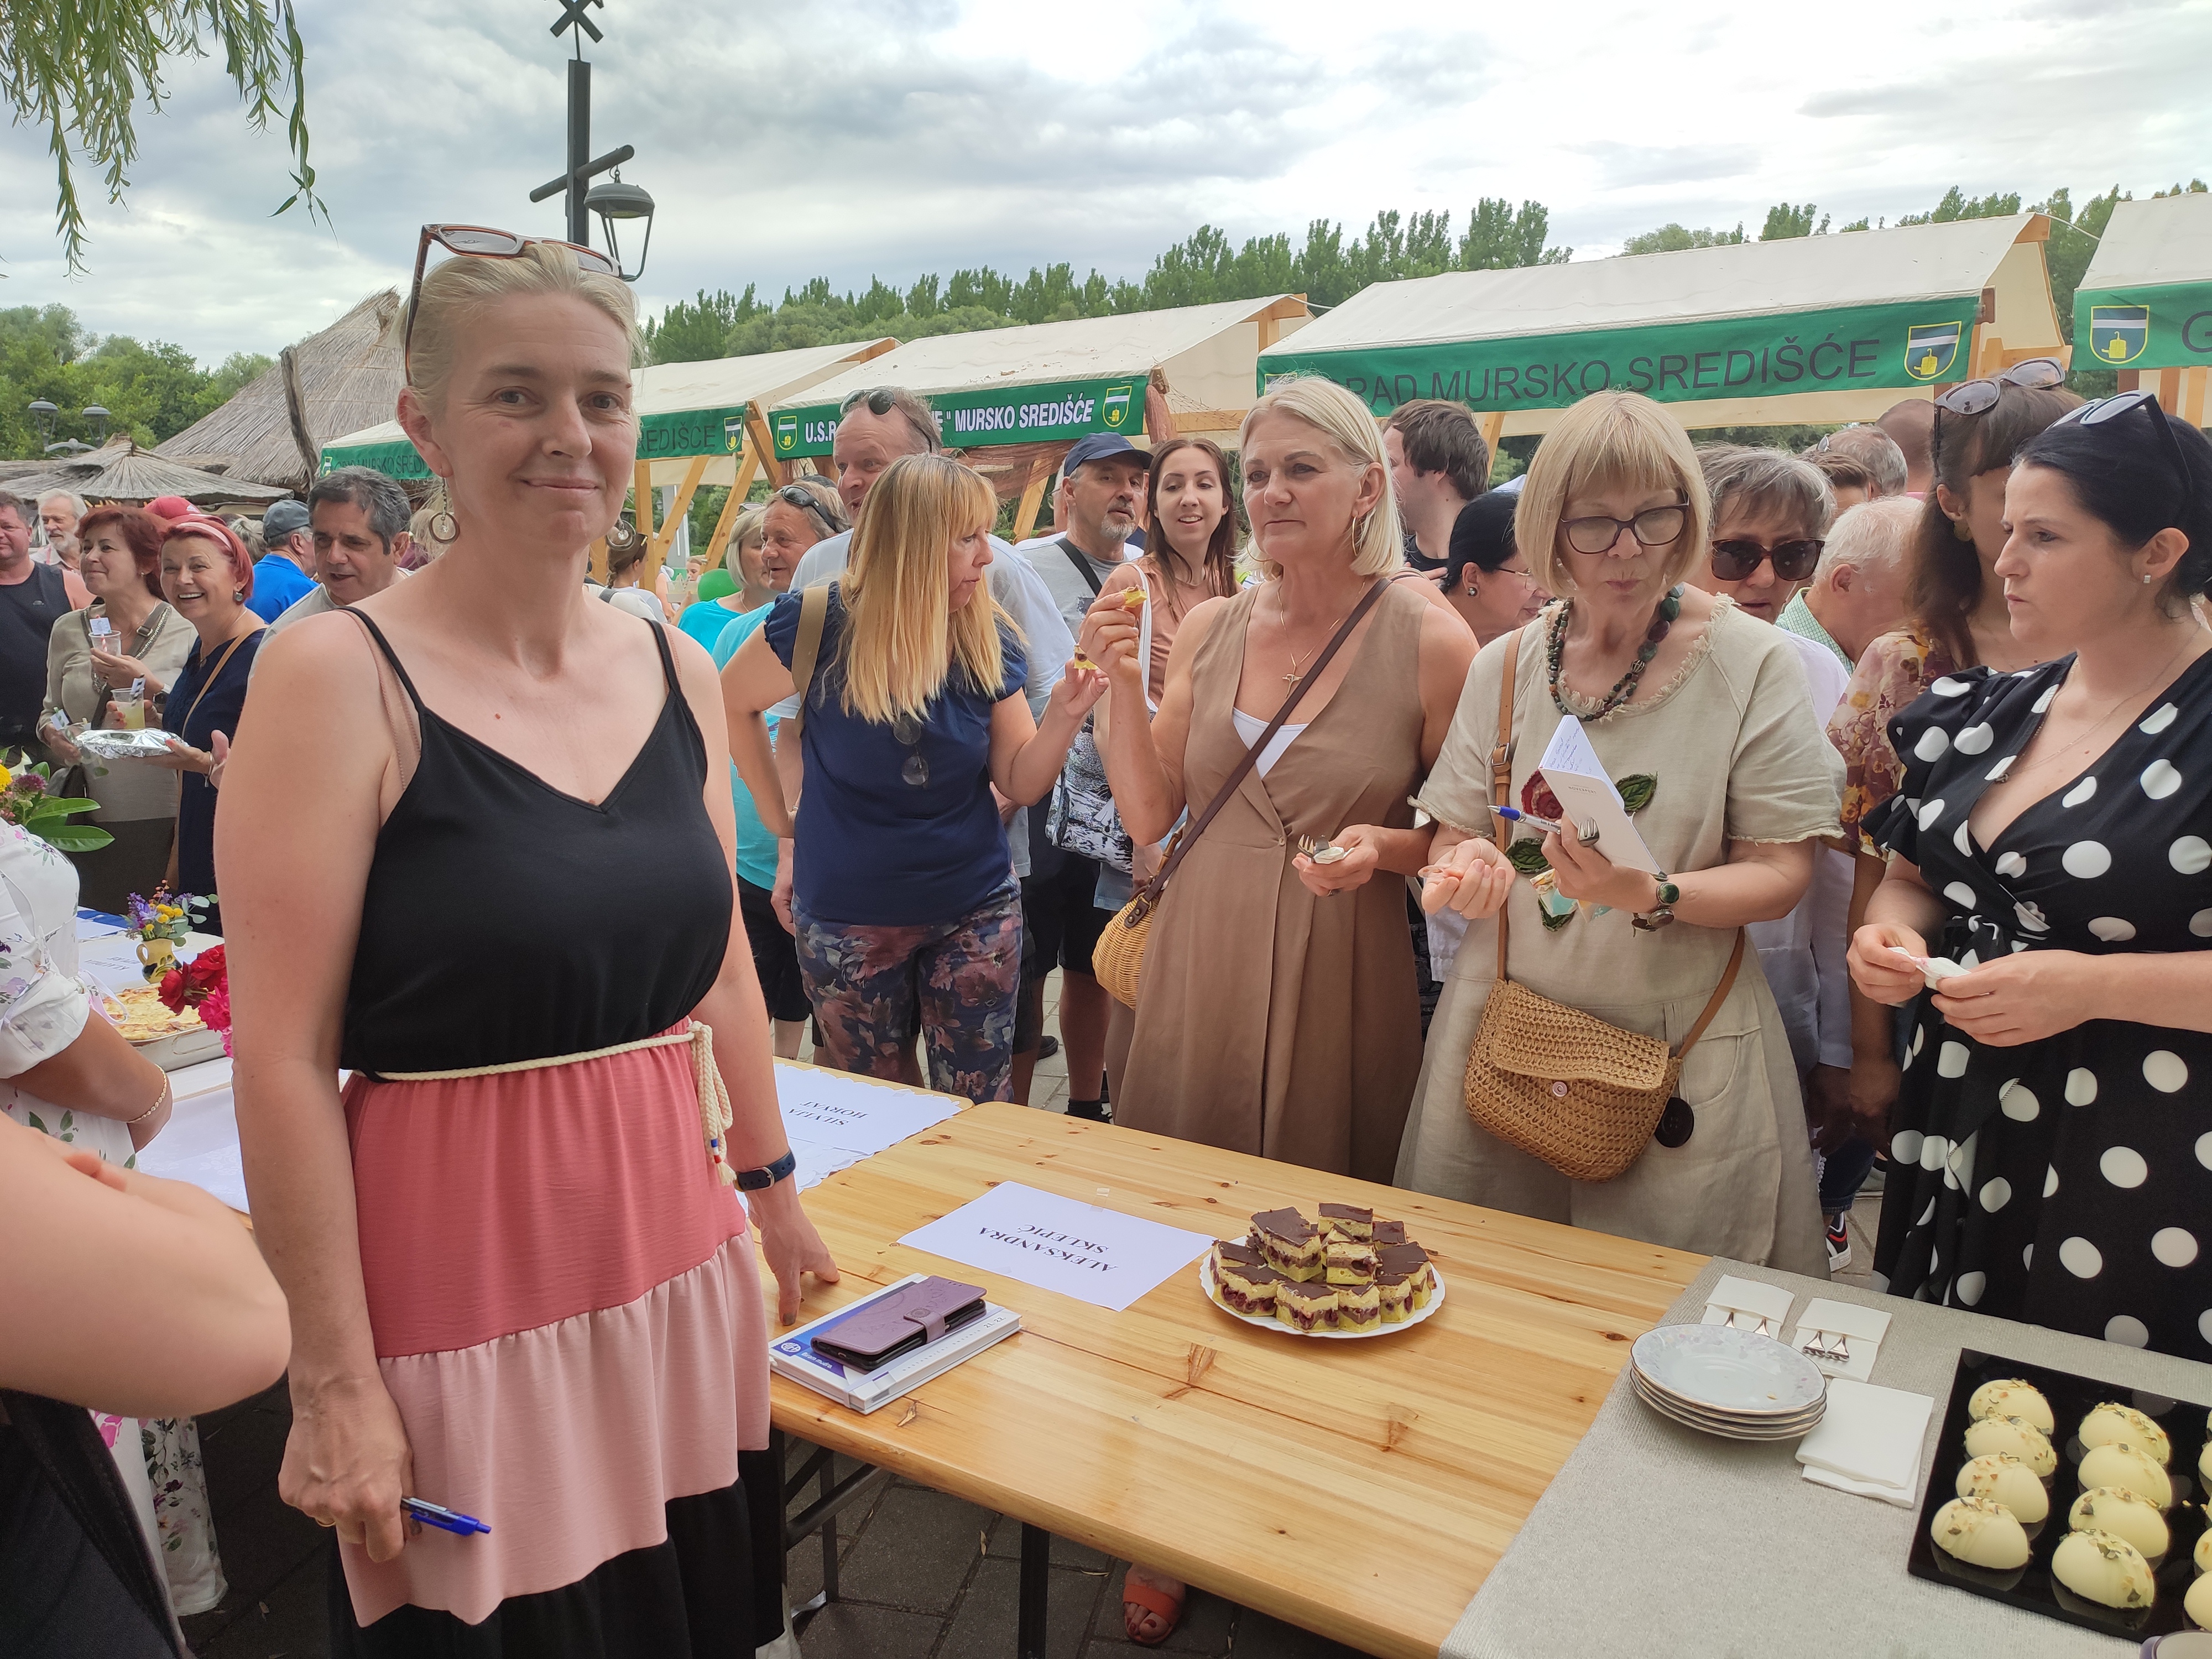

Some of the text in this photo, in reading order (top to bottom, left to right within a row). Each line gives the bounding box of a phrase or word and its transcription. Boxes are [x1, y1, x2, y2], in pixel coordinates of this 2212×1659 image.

[1432, 359, 1610, 402] MURSKO
[1627, 333, 1880, 392] SREDIŠĆE
[954, 405, 1015, 432] MURSKO
[1019, 392, 1095, 429] SREDIŠĆE
[789, 1108, 849, 1125] SILVIJA
[800, 1101, 869, 1118] HORVAT
[979, 1227, 1118, 1272] ALEKSANDRA
[1016, 1224, 1109, 1253] SKLEPIĆ
